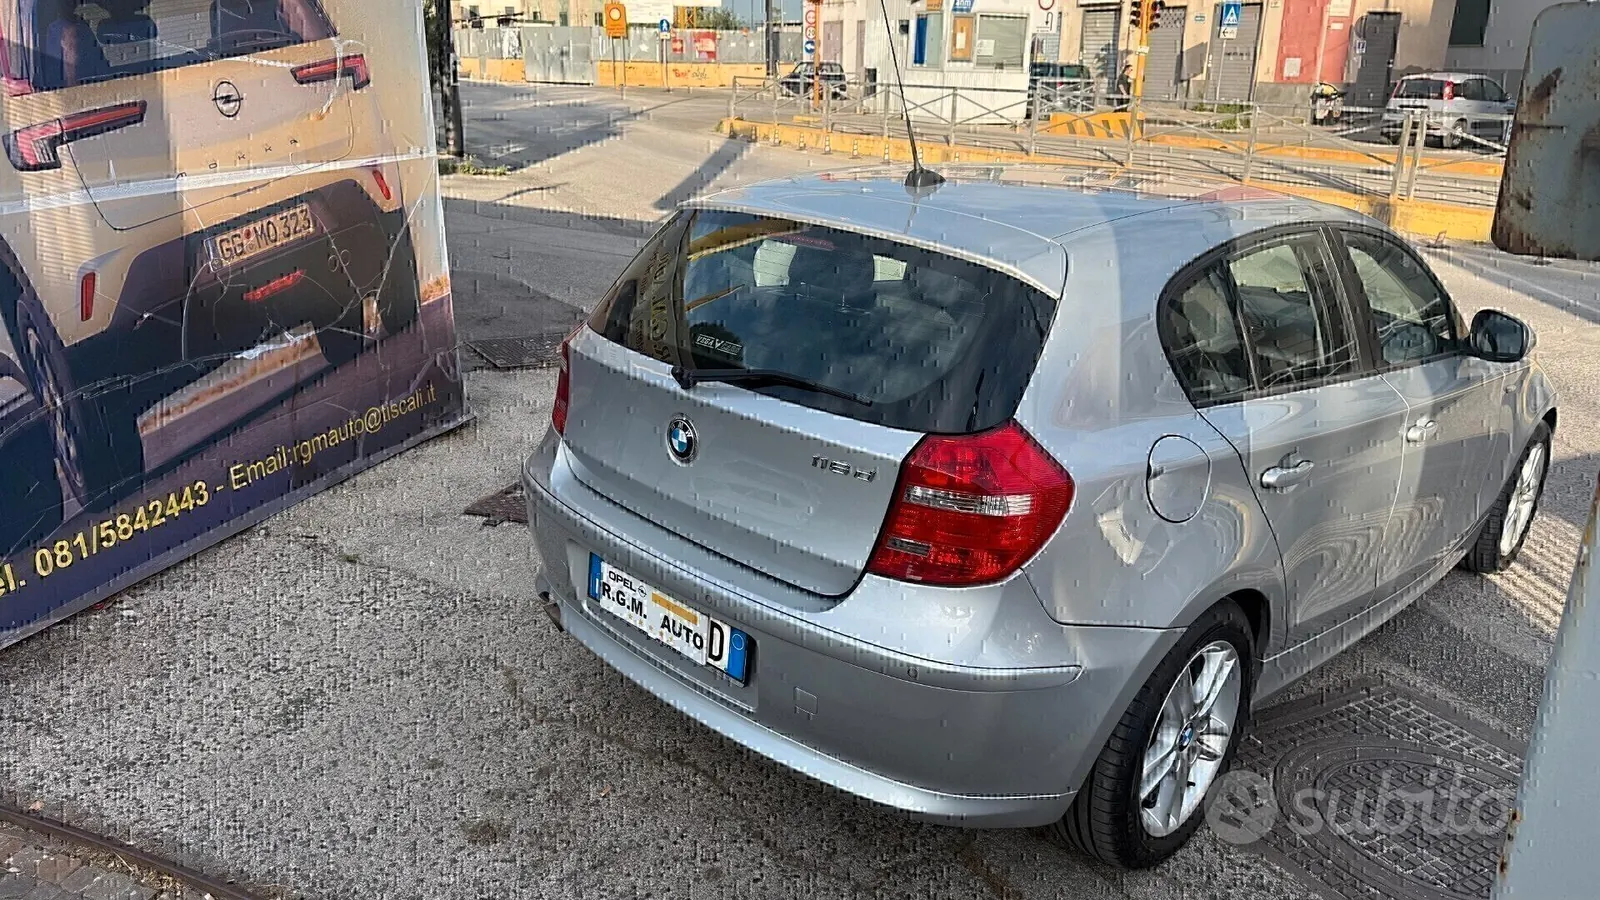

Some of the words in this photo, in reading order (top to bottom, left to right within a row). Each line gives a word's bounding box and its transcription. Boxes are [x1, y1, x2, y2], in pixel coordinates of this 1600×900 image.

[279, 208, 311, 241] 323
[35, 480, 209, 577] 081/5842443
[229, 384, 437, 490] Email:rgmauto@tiscali.it
[608, 570, 637, 593] OPEL
[602, 581, 648, 620] R.G.M.
[660, 614, 704, 651] AUTO
[708, 619, 725, 662] D
